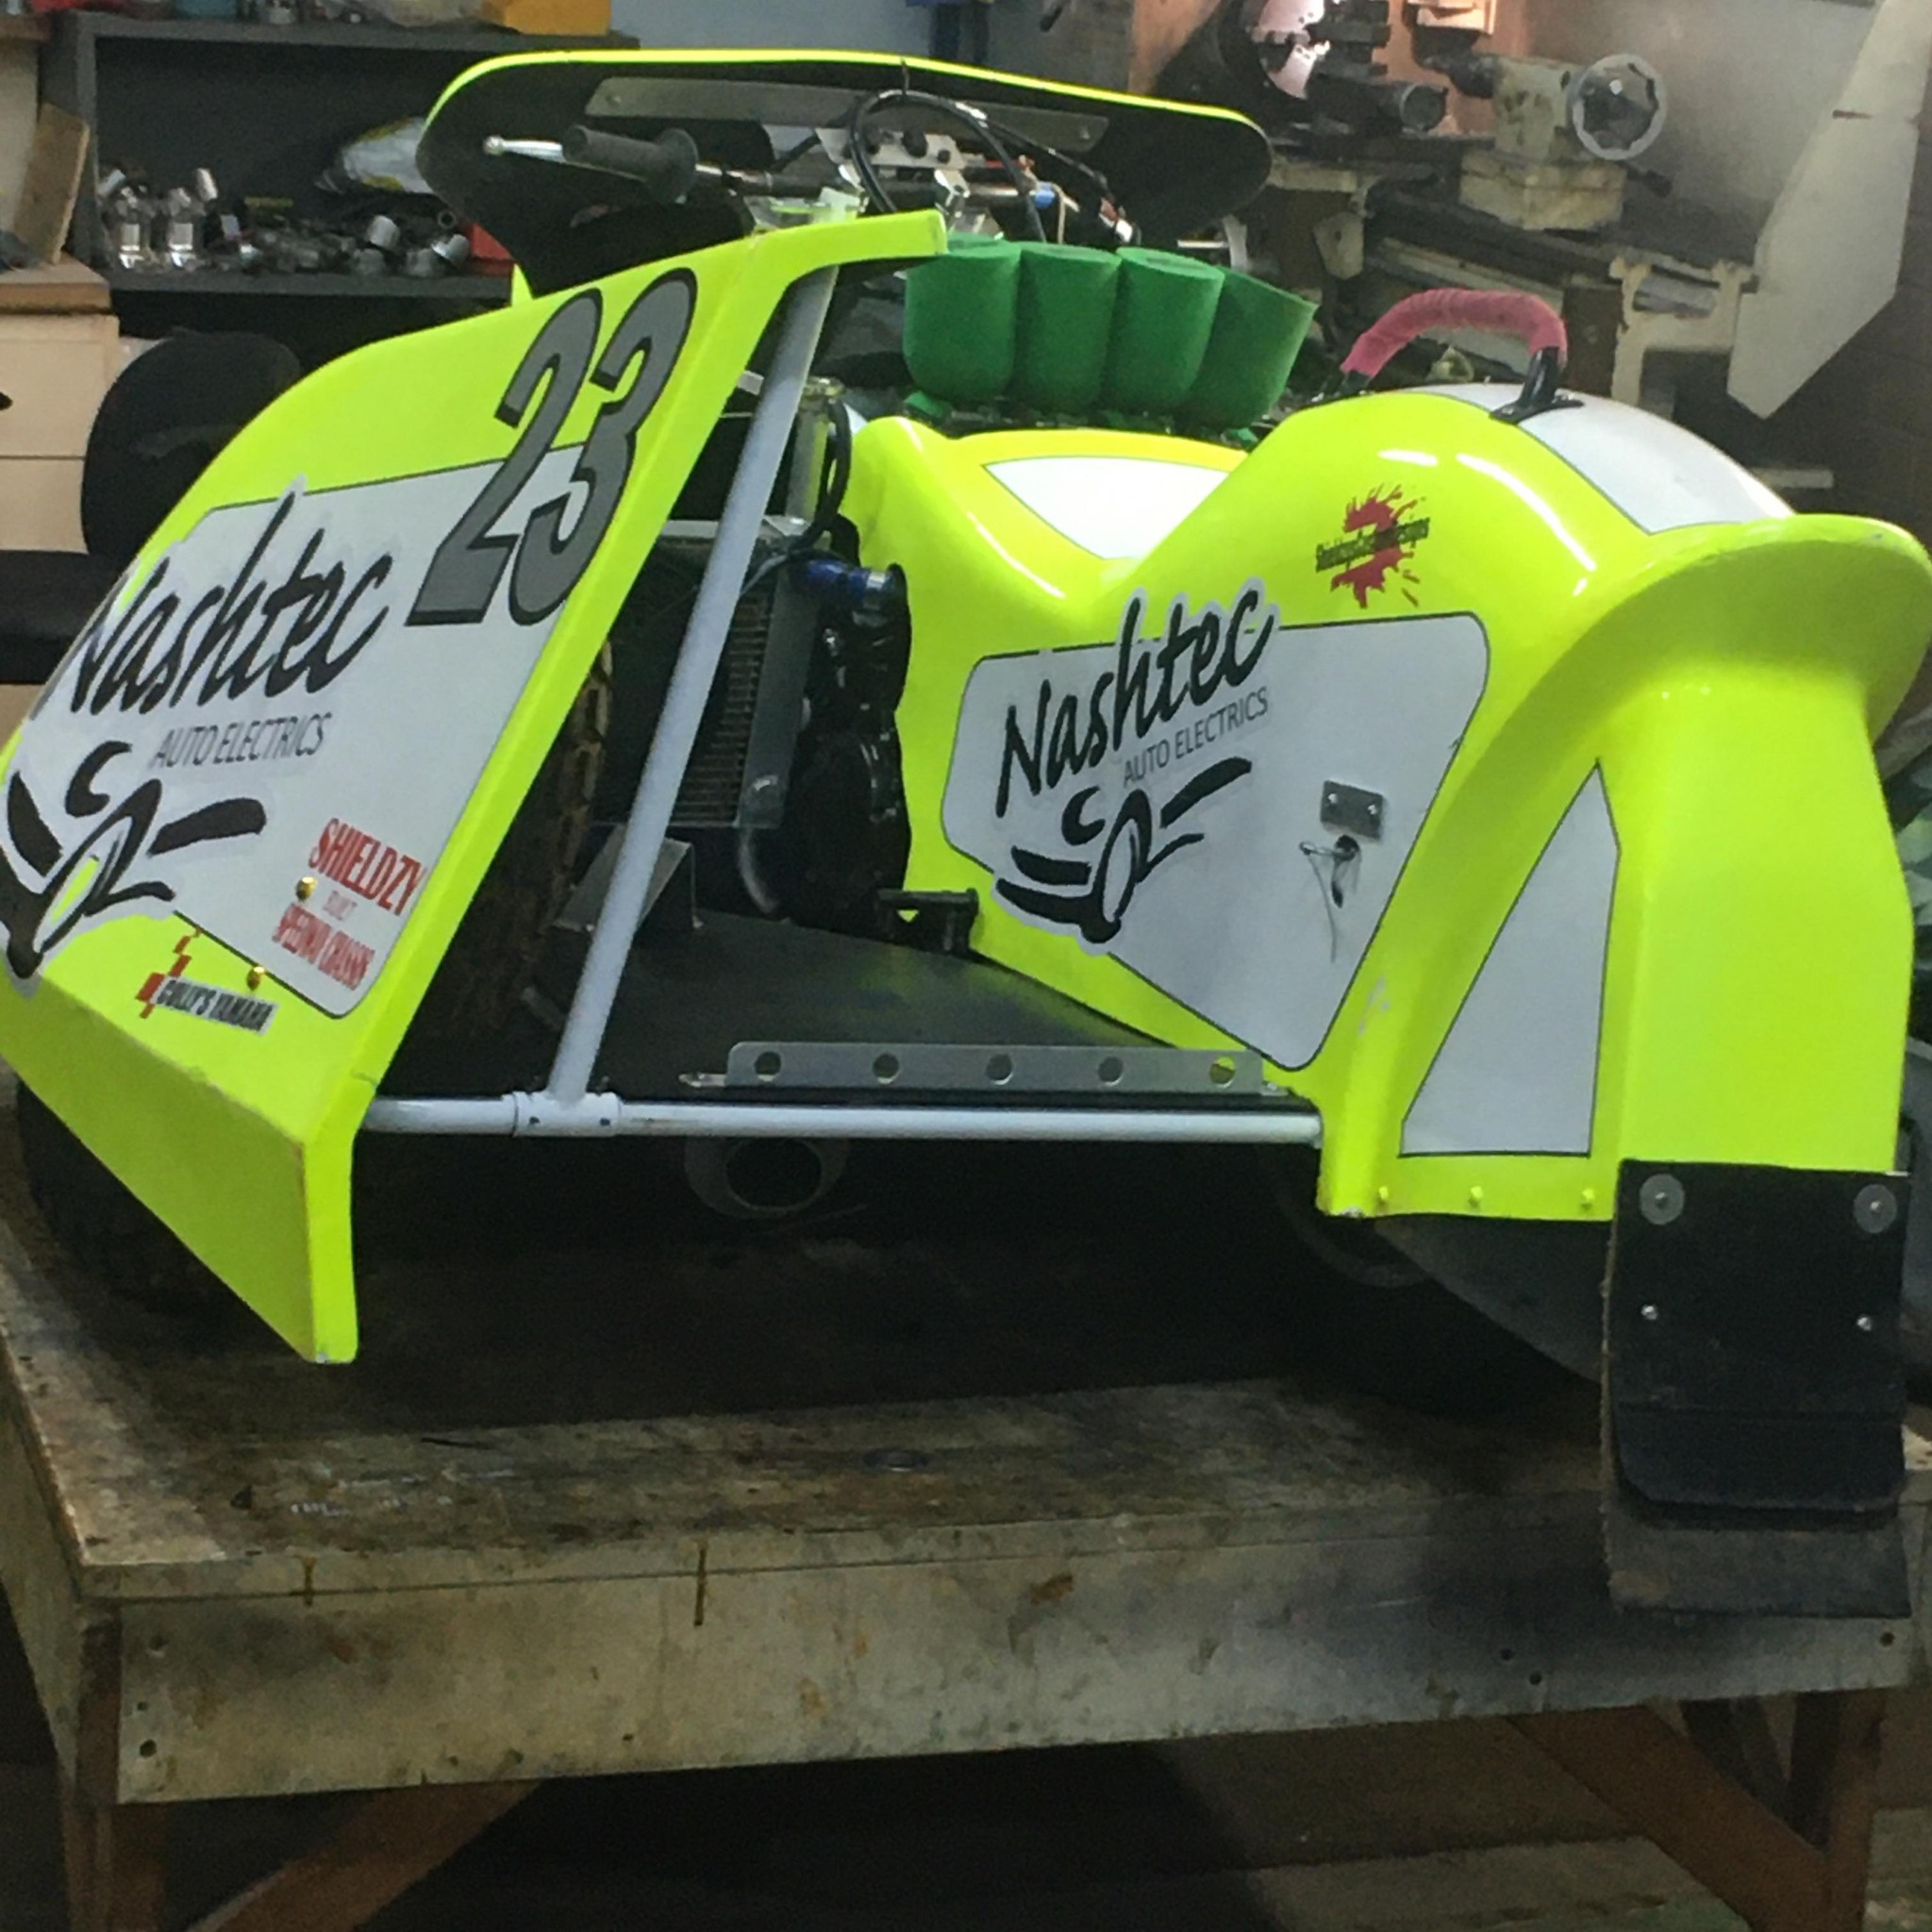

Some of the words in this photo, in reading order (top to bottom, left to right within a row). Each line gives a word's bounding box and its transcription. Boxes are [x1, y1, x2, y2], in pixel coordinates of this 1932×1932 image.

[405, 267, 698, 626] 23
[71, 491, 393, 715] Nashtec
[148, 724, 219, 769] AUTO
[212, 712, 332, 765] ELECTRICS
[995, 589, 1275, 819] Nashtec
[1124, 739, 1171, 798] AUTO
[1174, 686, 1269, 760] ELECTRICS
[308, 817, 428, 918] SHIELDZY
